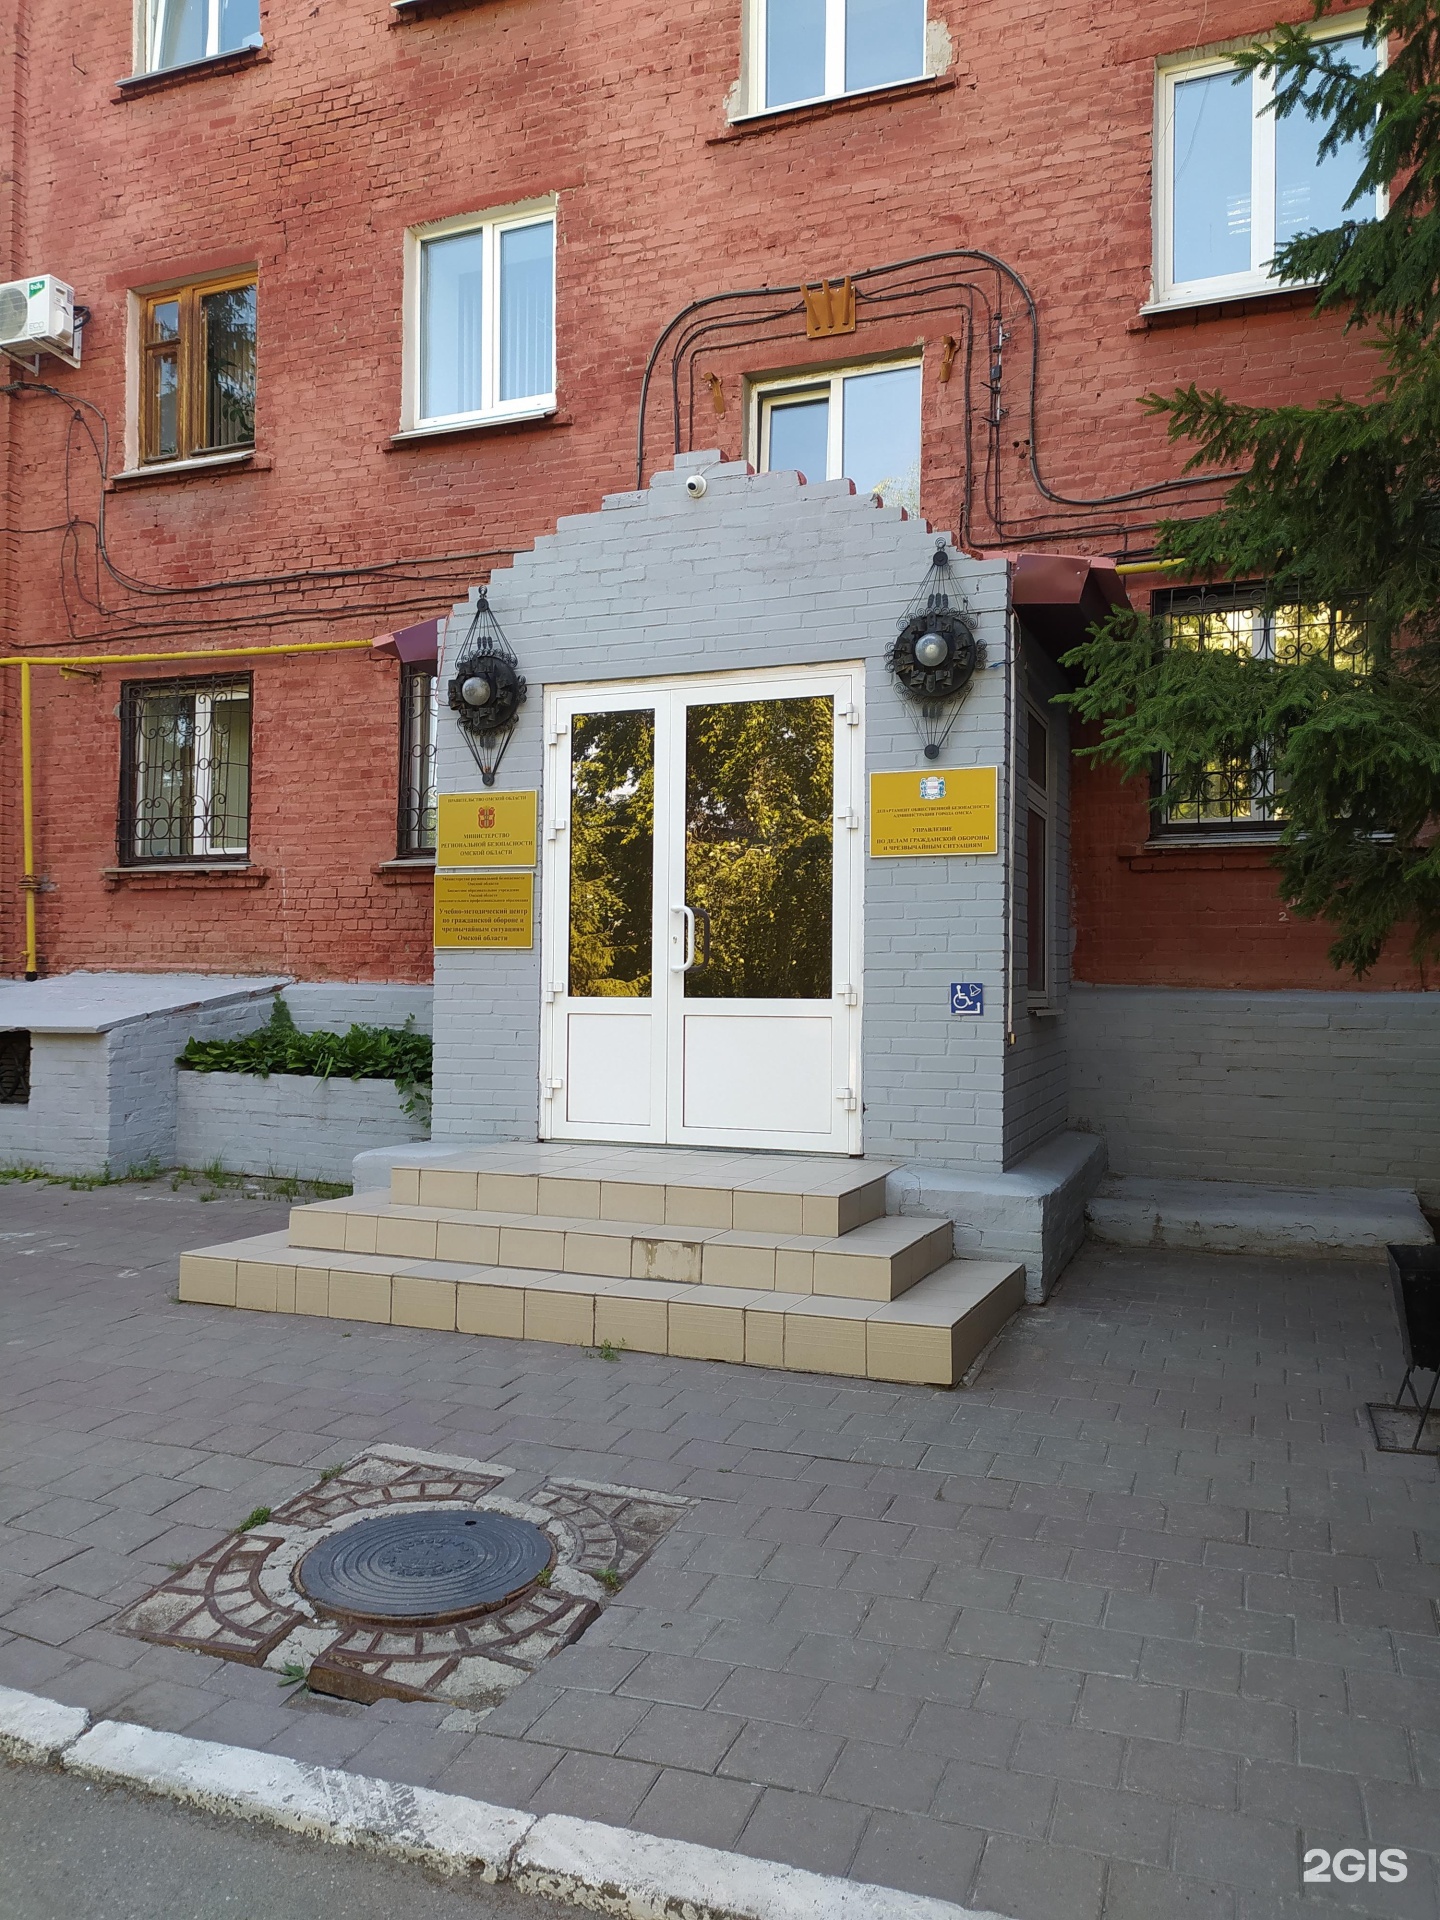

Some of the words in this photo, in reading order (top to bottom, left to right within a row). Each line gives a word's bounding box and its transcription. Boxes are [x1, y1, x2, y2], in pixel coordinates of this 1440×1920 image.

[910, 835, 957, 843] ГРАЖДАНСКОЙ
[889, 843, 942, 851] ЧРЕЗВЫЧАЙНЫМ
[510, 909, 528, 917] центр
[452, 917, 492, 926] гражданской
[494, 917, 518, 925] обороне
[442, 925, 489, 933] чрезвычайным
